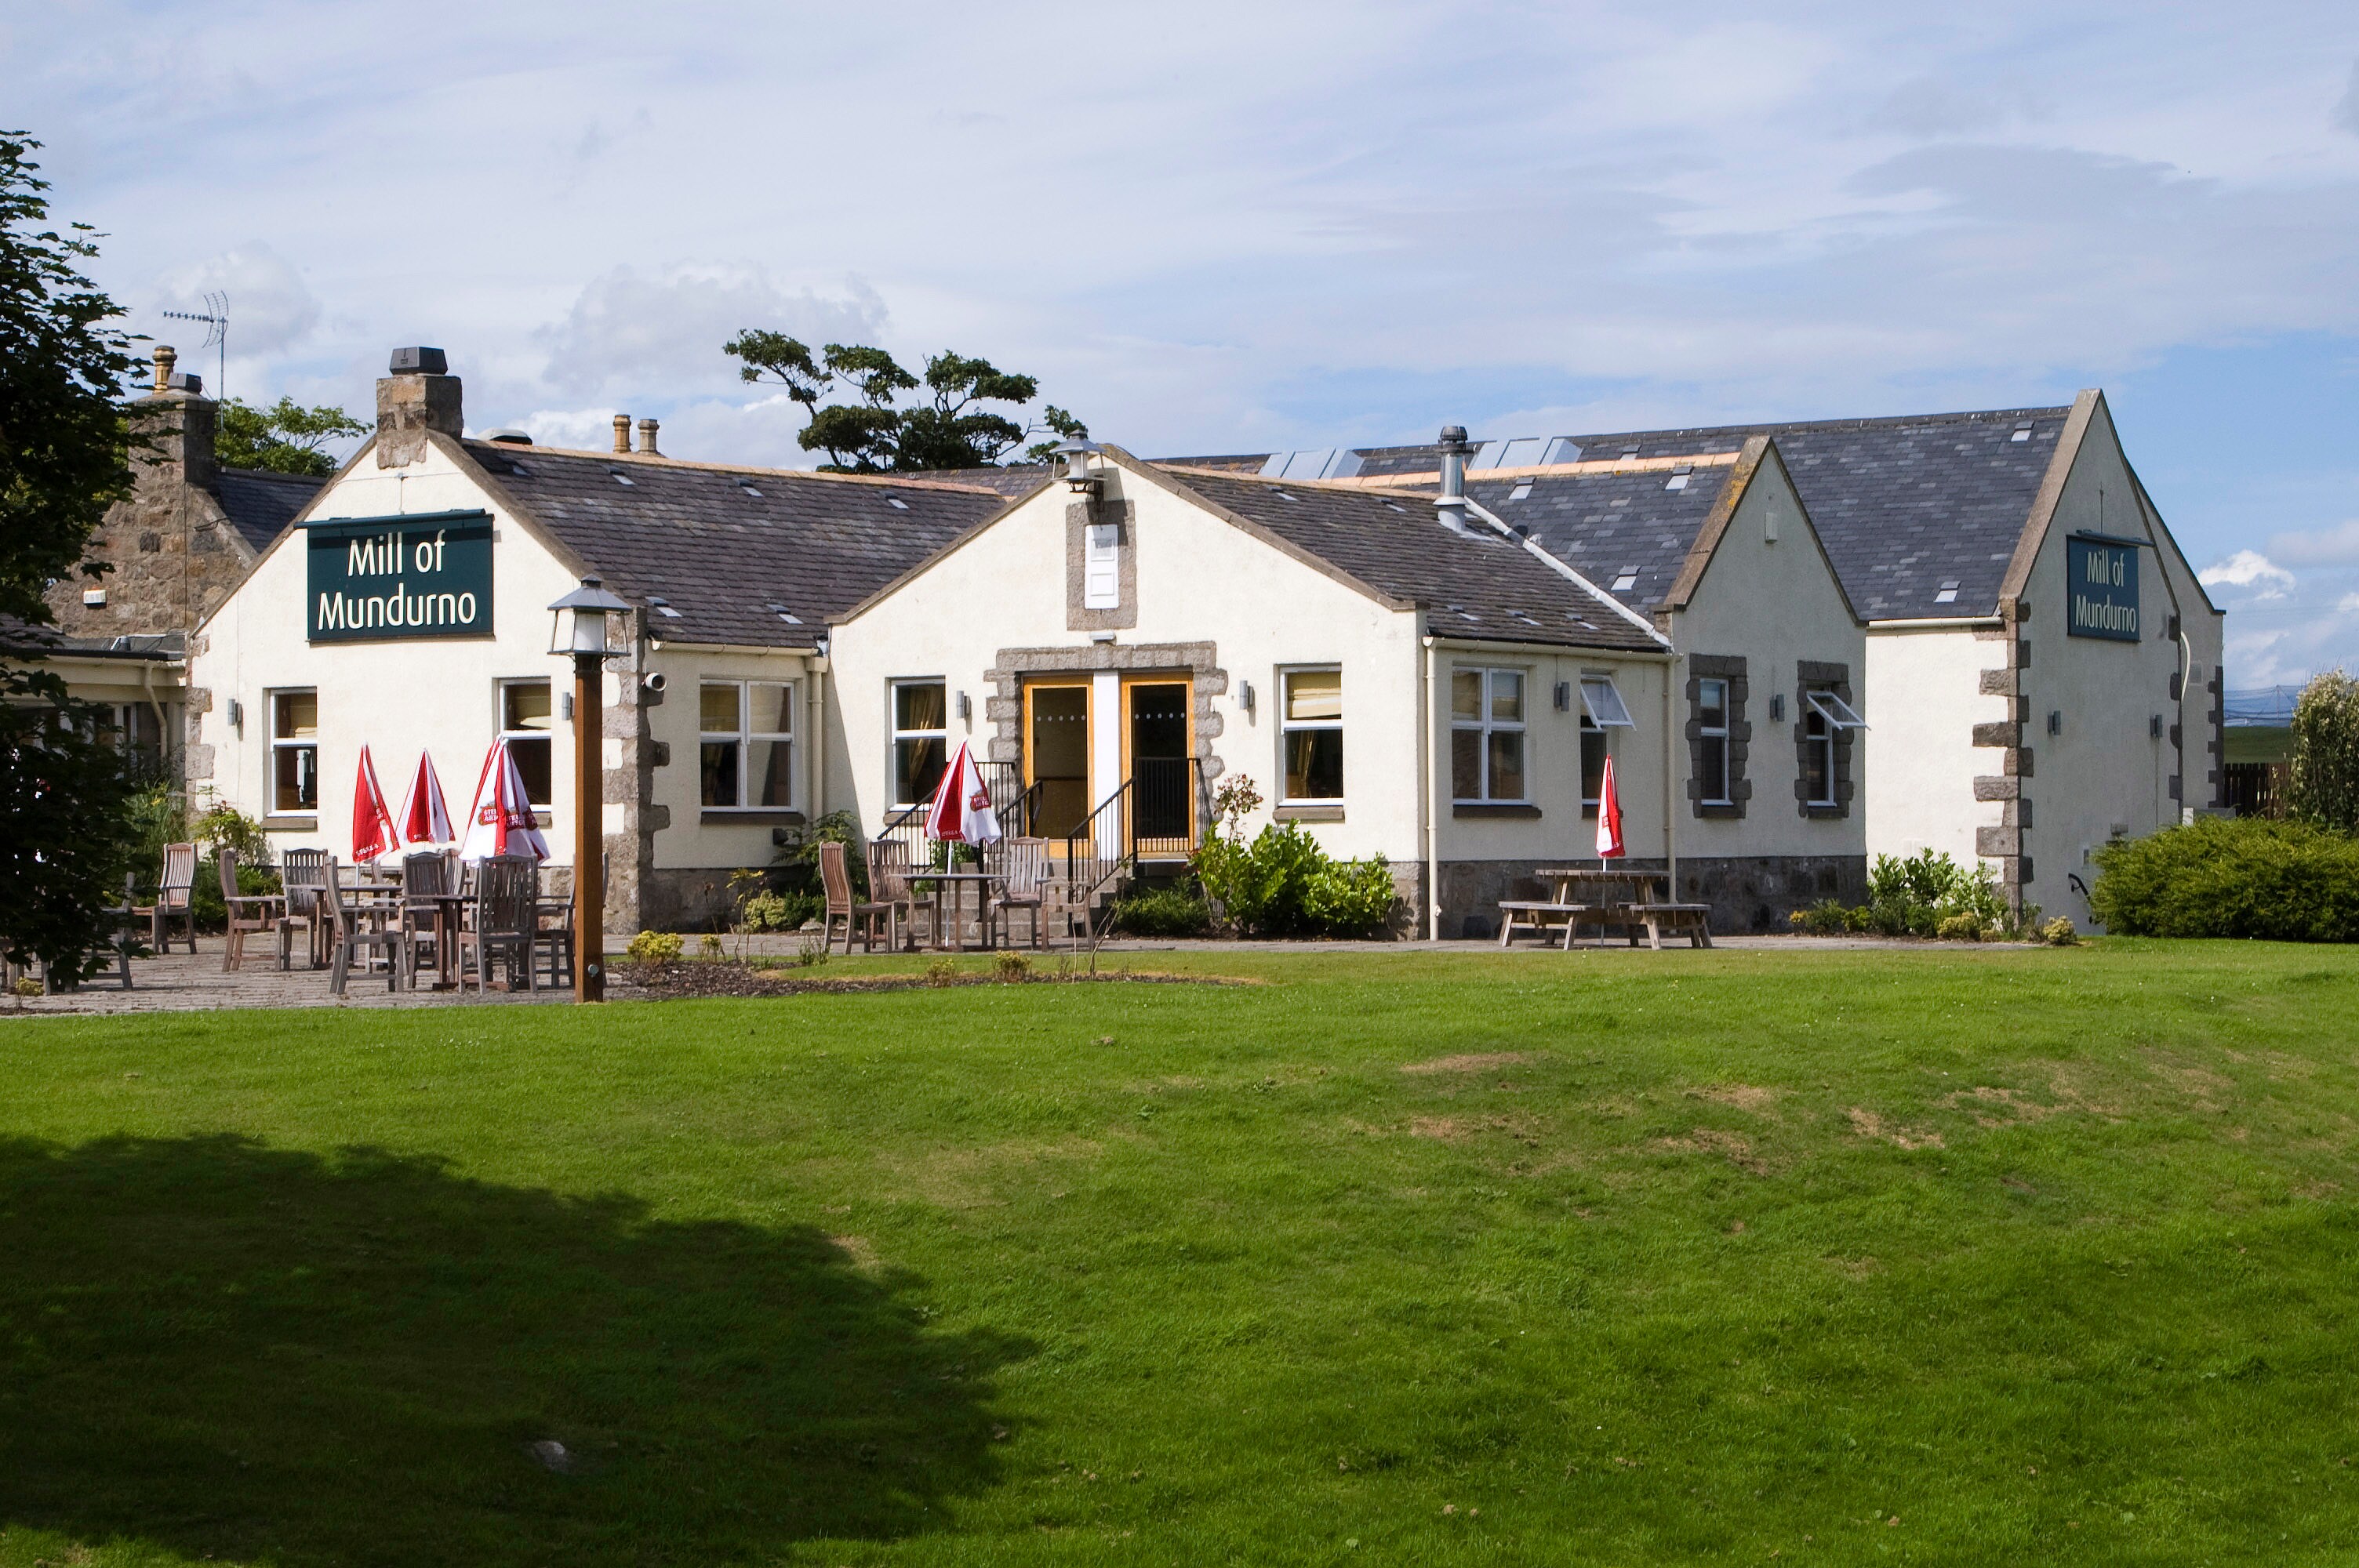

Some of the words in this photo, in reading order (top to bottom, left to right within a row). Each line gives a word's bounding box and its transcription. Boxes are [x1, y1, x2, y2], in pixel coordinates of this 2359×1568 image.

[347, 531, 403, 576] Mill
[414, 528, 445, 573] of
[2087, 549, 2110, 585] Mill
[2112, 553, 2125, 587] of
[318, 583, 476, 630] Mundurno
[2075, 593, 2136, 633] Mundurno
